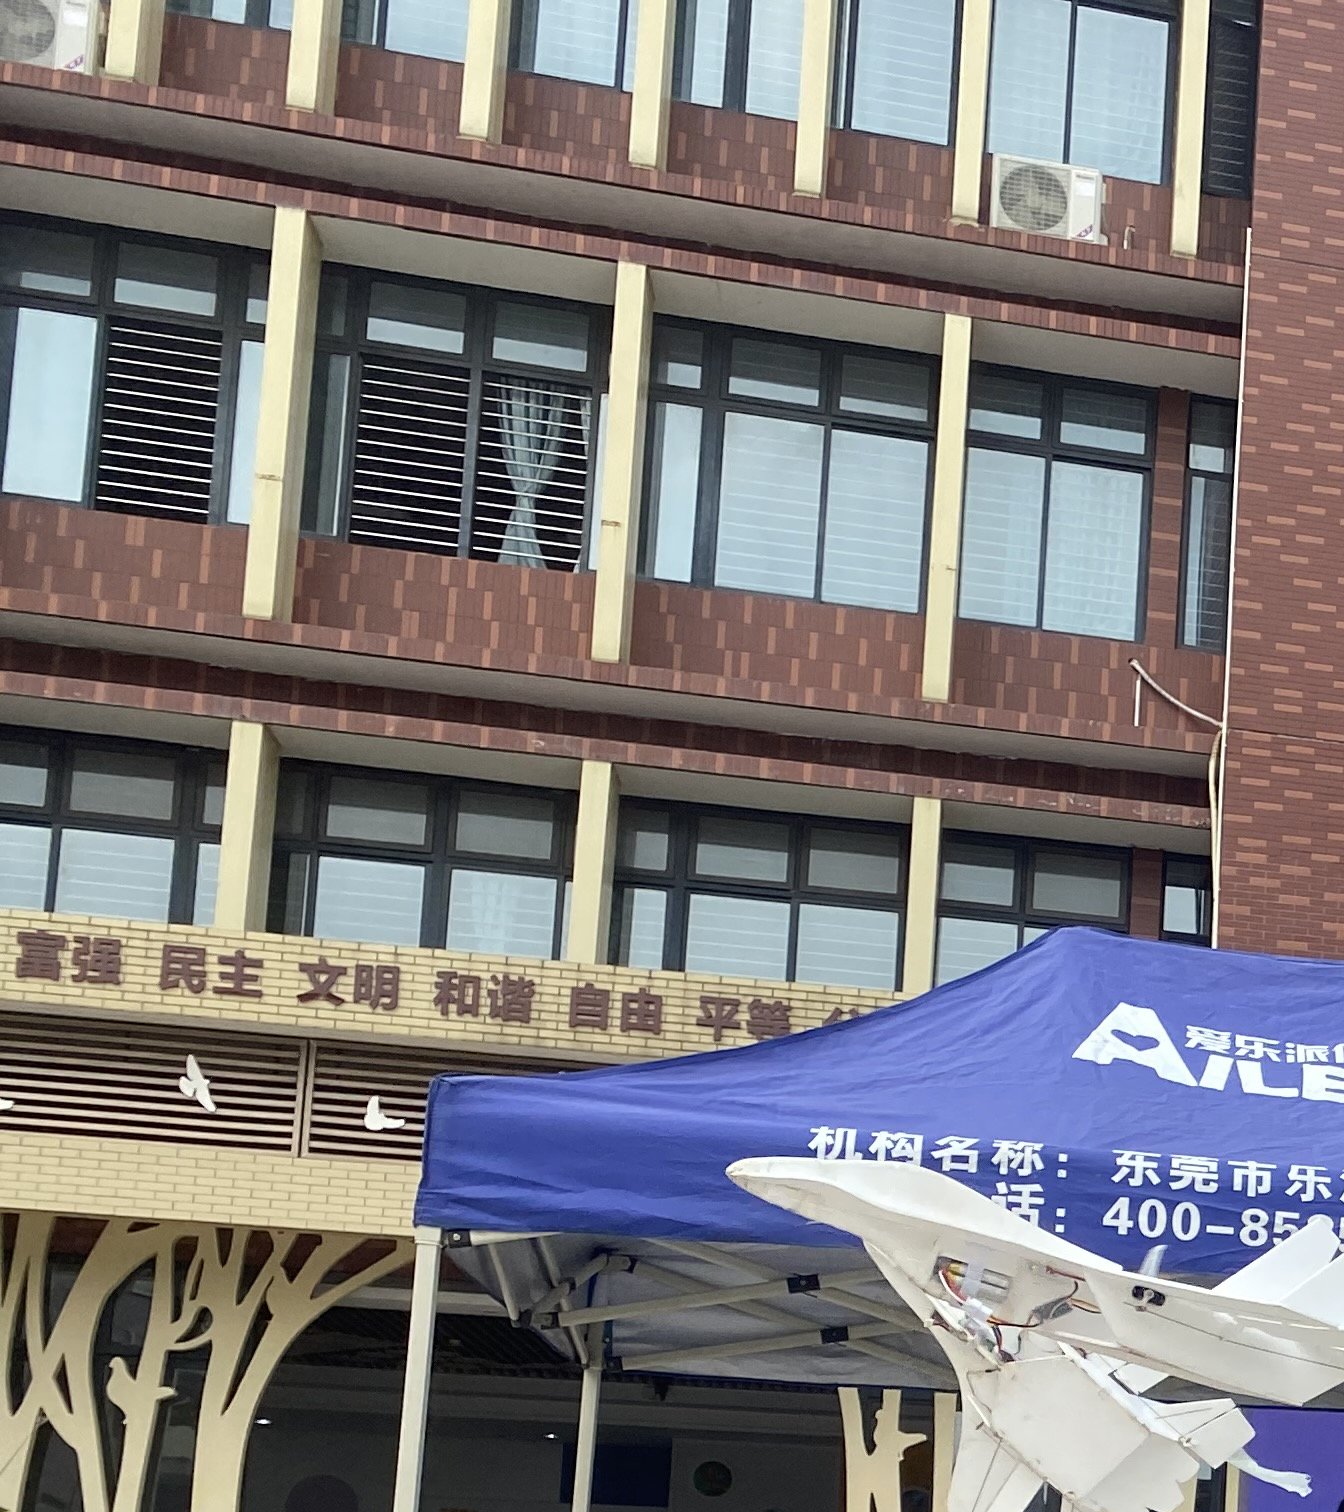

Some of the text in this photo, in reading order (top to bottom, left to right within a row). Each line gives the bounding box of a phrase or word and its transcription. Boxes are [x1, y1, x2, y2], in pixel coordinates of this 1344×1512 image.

[16, 930, 792, 1041] 富强 民主 文明 和谐 自由 平等
